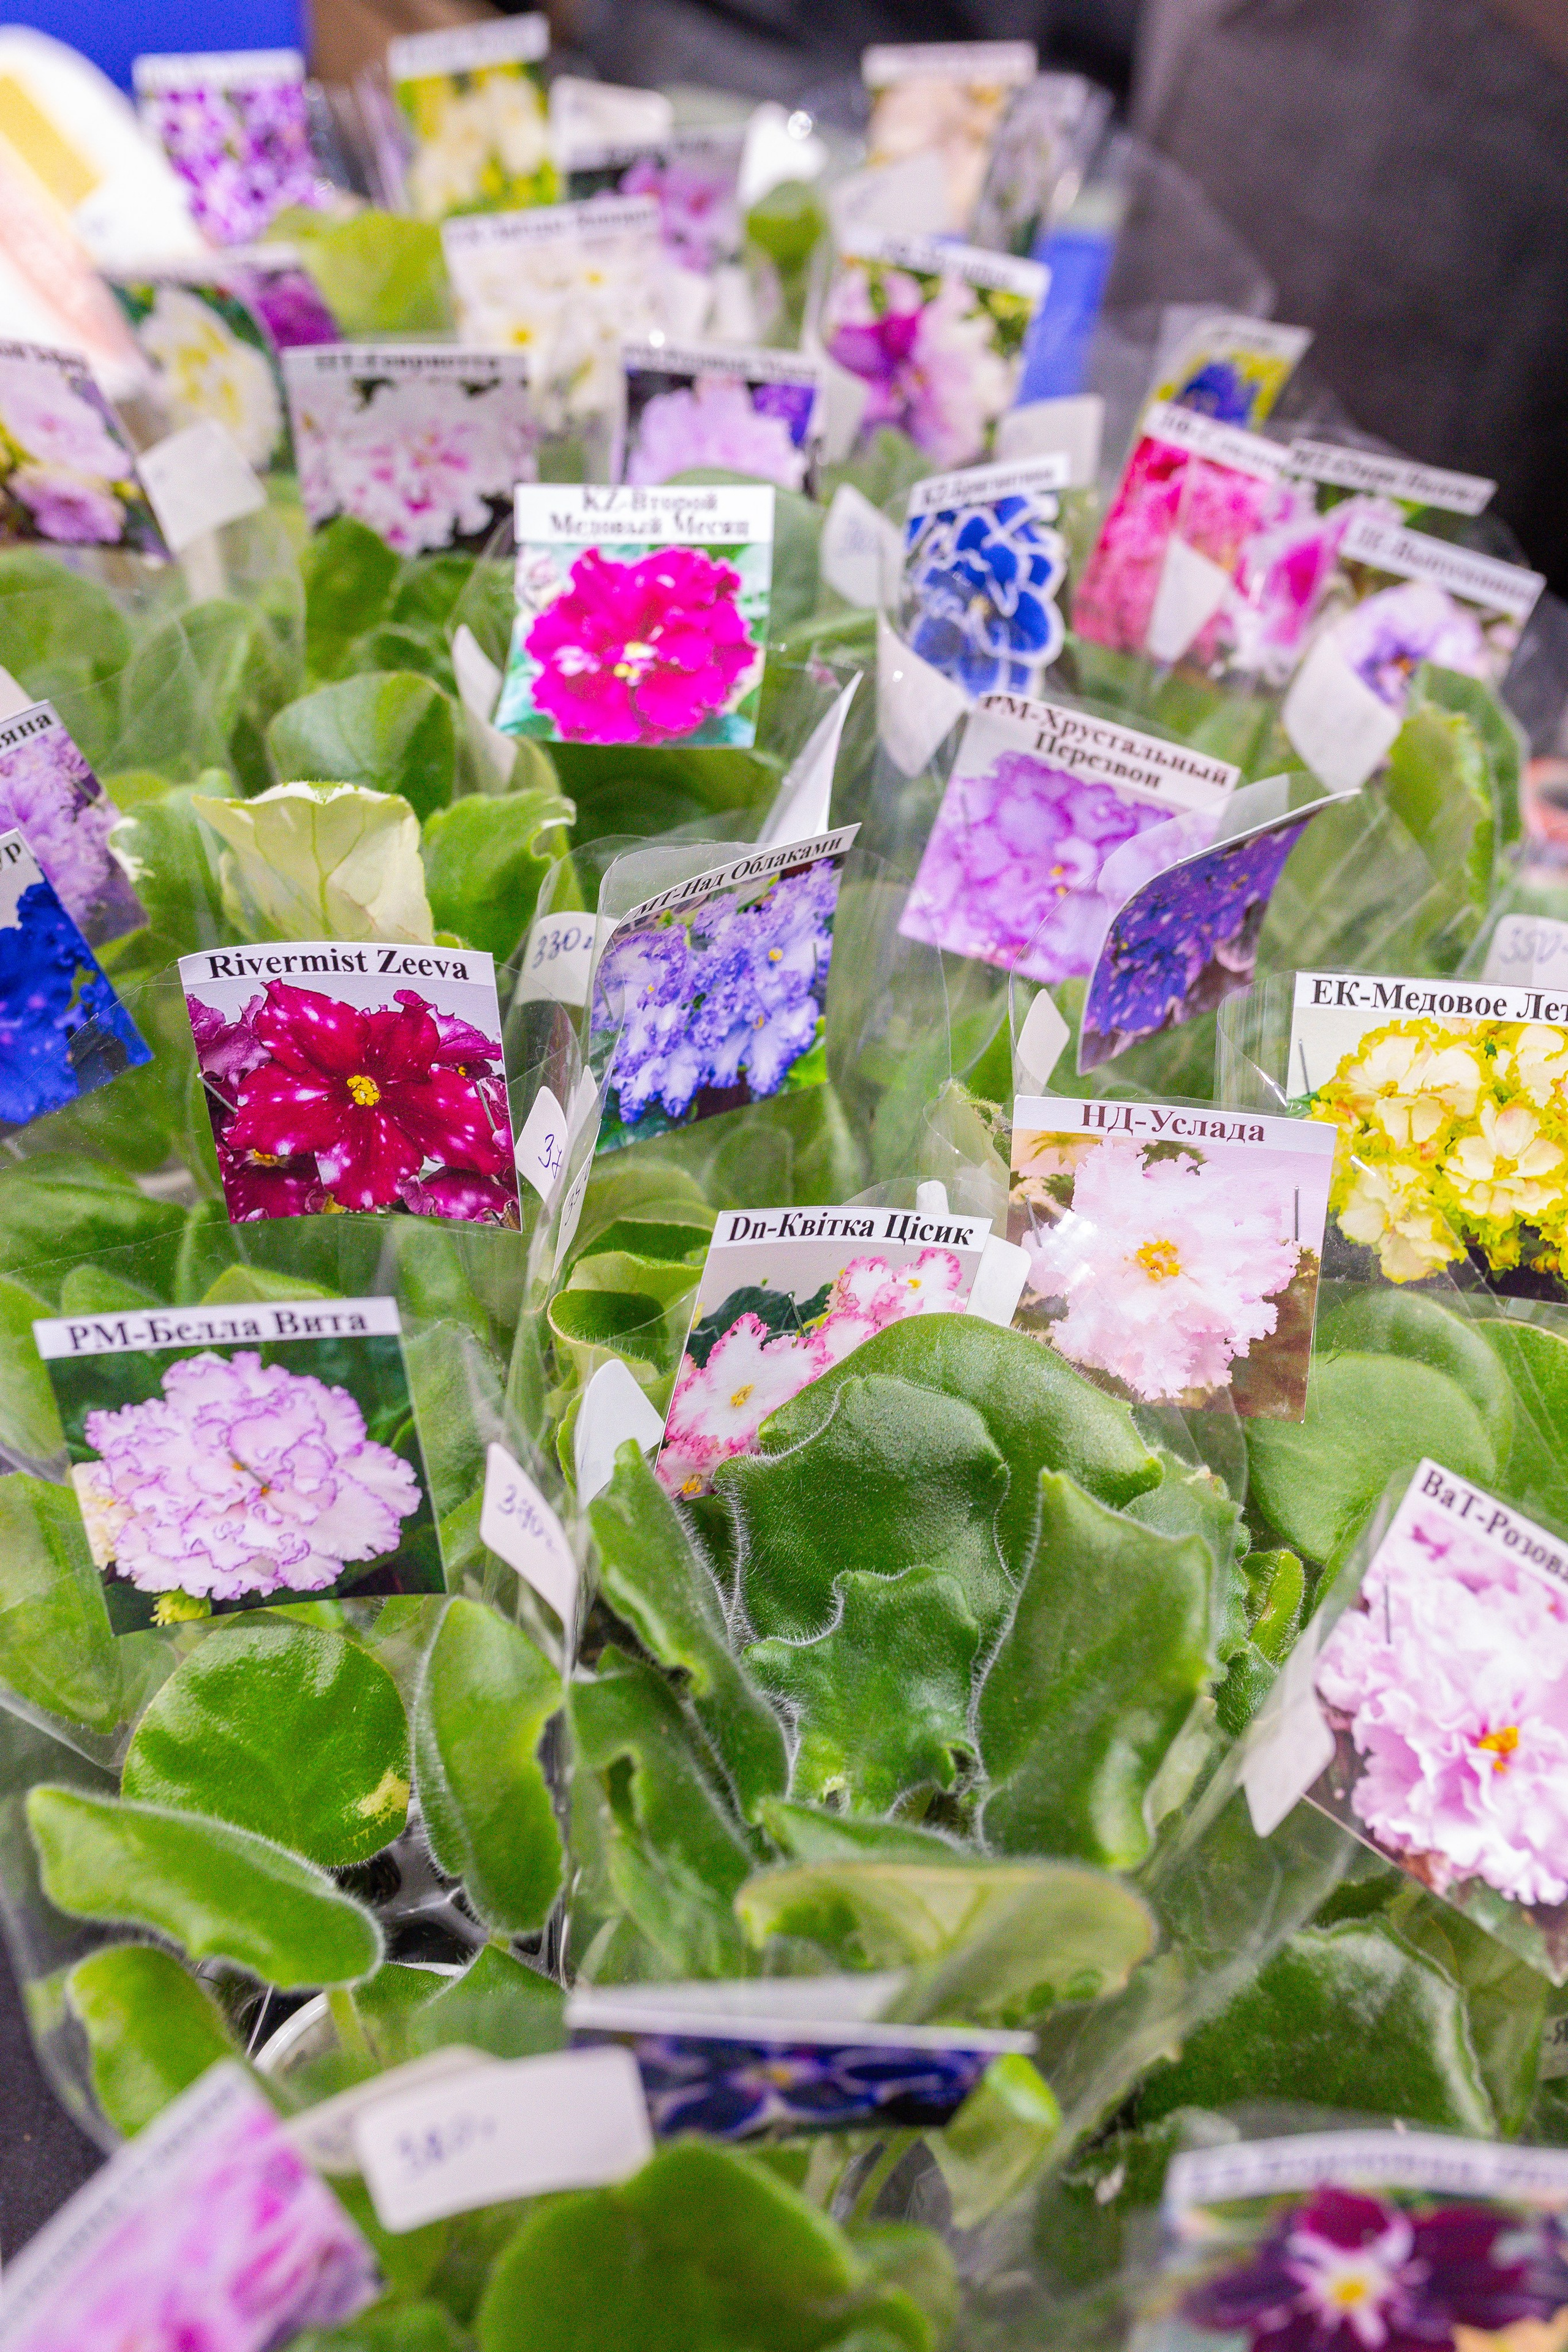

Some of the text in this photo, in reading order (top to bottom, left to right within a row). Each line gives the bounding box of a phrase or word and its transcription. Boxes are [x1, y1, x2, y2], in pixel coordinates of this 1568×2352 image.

[0, 714, 53, 748] яна
[1034, 733, 1161, 790] Перезвон
[631, 836, 843, 919] МТ-Над Облаками
[205, 948, 470, 981] Rivermist Zeeva
[1310, 979, 1508, 1017] ЕК-Медовое
[1080, 1104, 1265, 1144] НД-Услада
[882, 1213, 974, 1246] Цісик
[65, 1308, 368, 1351] РМ-Белла Вита
